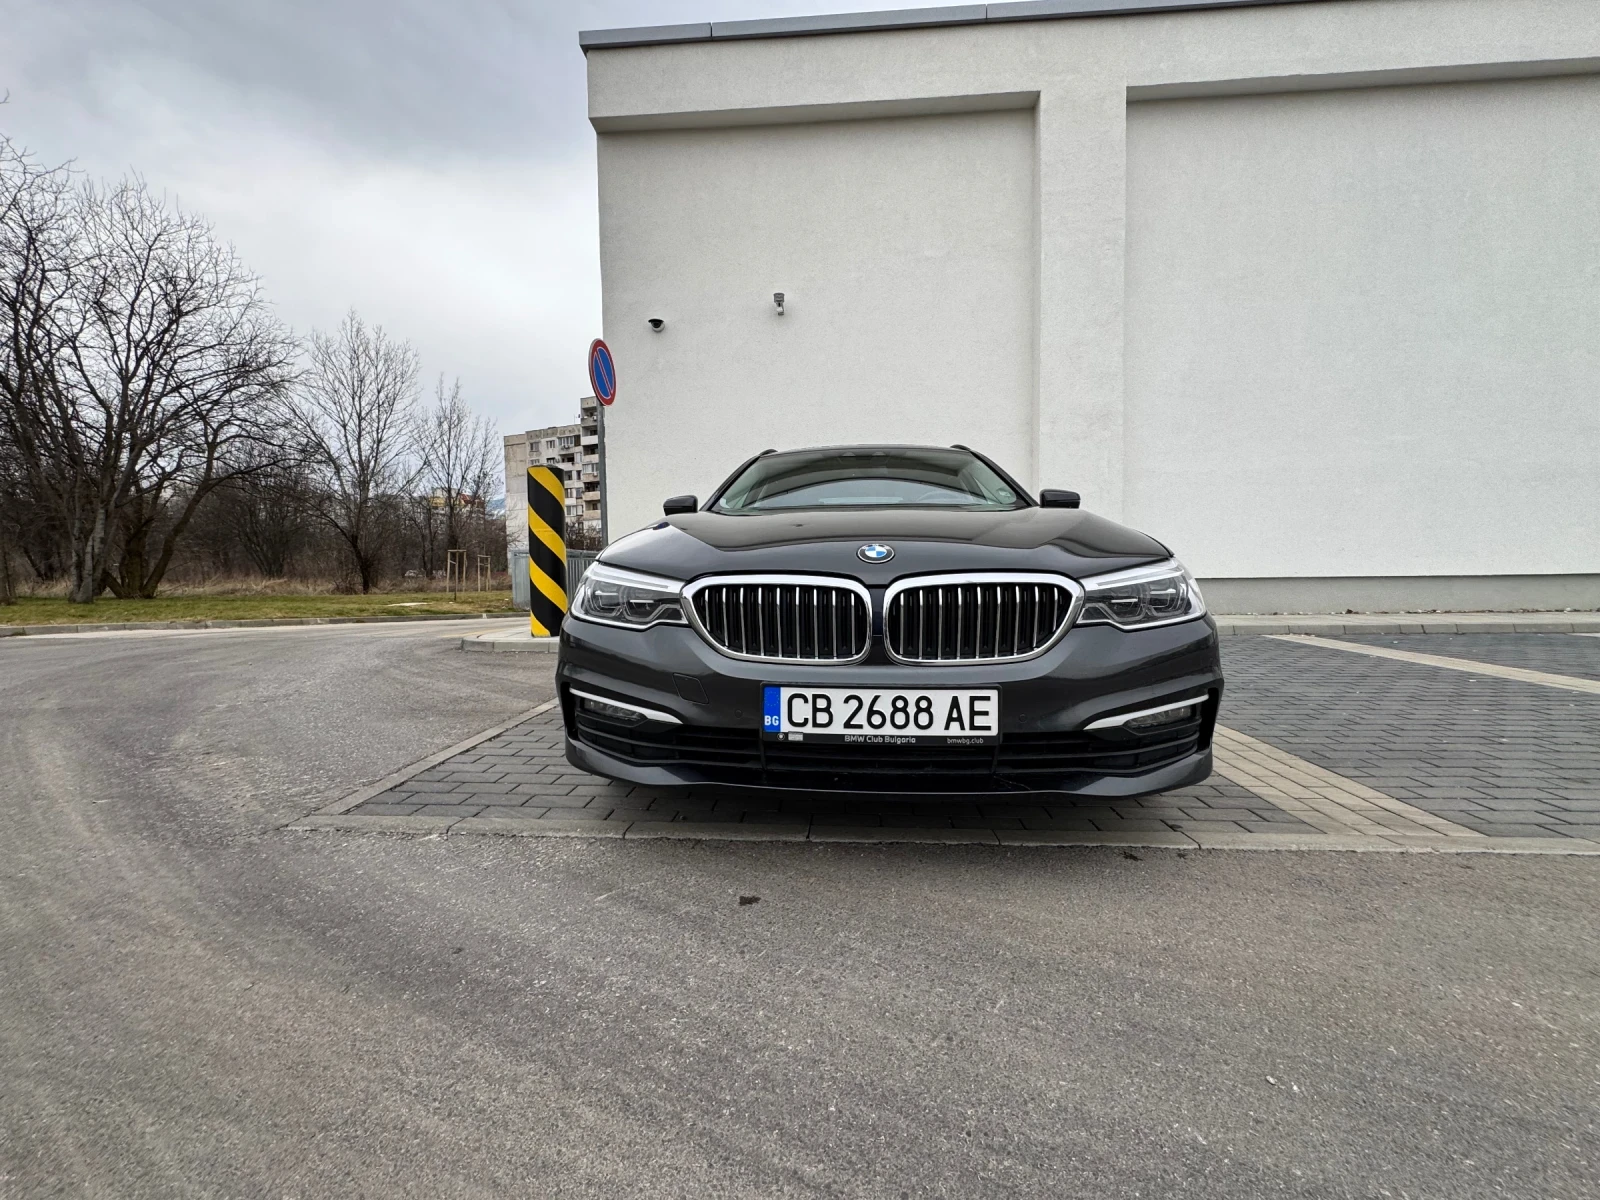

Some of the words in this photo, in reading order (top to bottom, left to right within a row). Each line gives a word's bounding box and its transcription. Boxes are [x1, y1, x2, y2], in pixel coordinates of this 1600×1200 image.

[787, 693, 834, 728] CB
[843, 694, 934, 730] 2688
[944, 695, 992, 731] AE
[764, 715, 780, 726] BG
[844, 735, 865, 743] BMW
[866, 735, 884, 743] Club
[884, 735, 916, 745] Bulgaria
[946, 737, 984, 745] bmwbg.club
